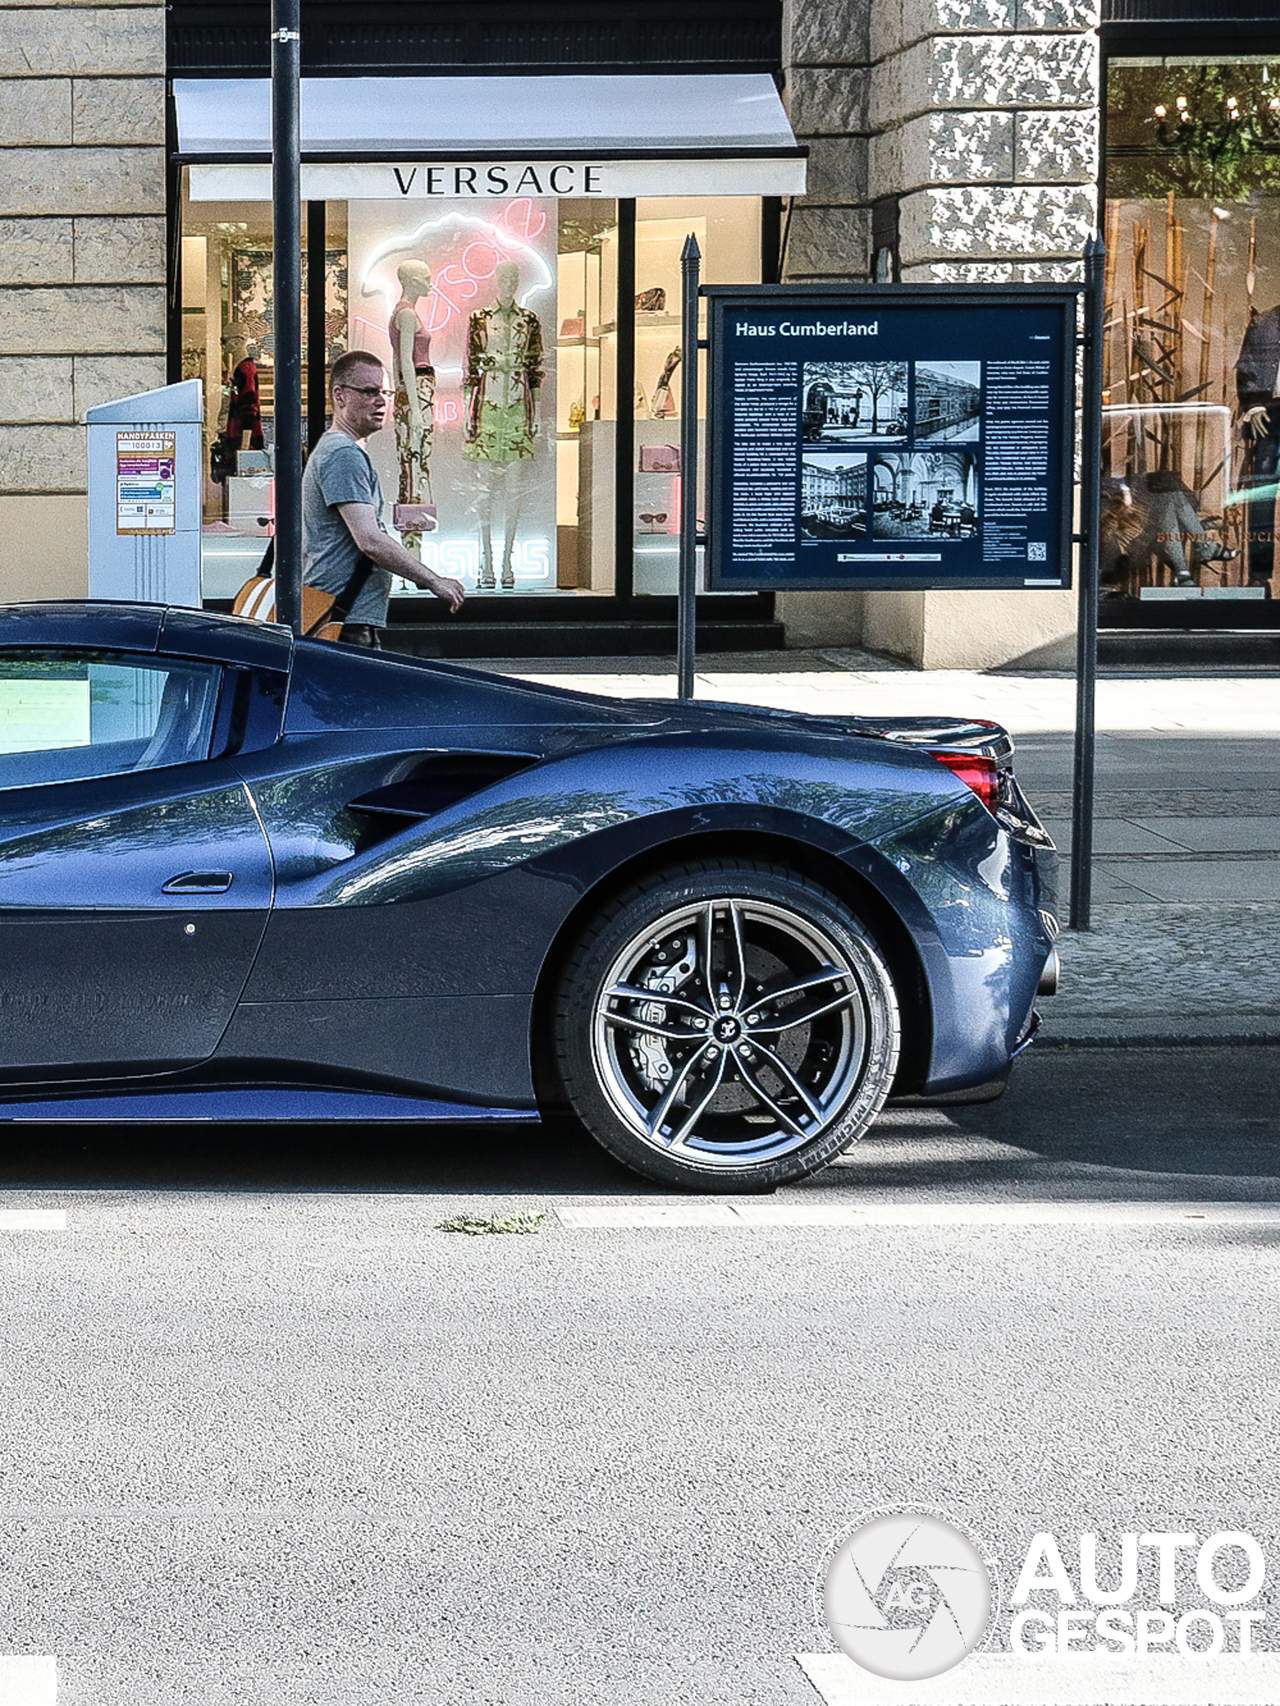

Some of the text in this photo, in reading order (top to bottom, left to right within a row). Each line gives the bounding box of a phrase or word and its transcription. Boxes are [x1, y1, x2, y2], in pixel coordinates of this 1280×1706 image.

[393, 165, 603, 195] VERSACE
[735, 321, 879, 336] Haus Cumberland
